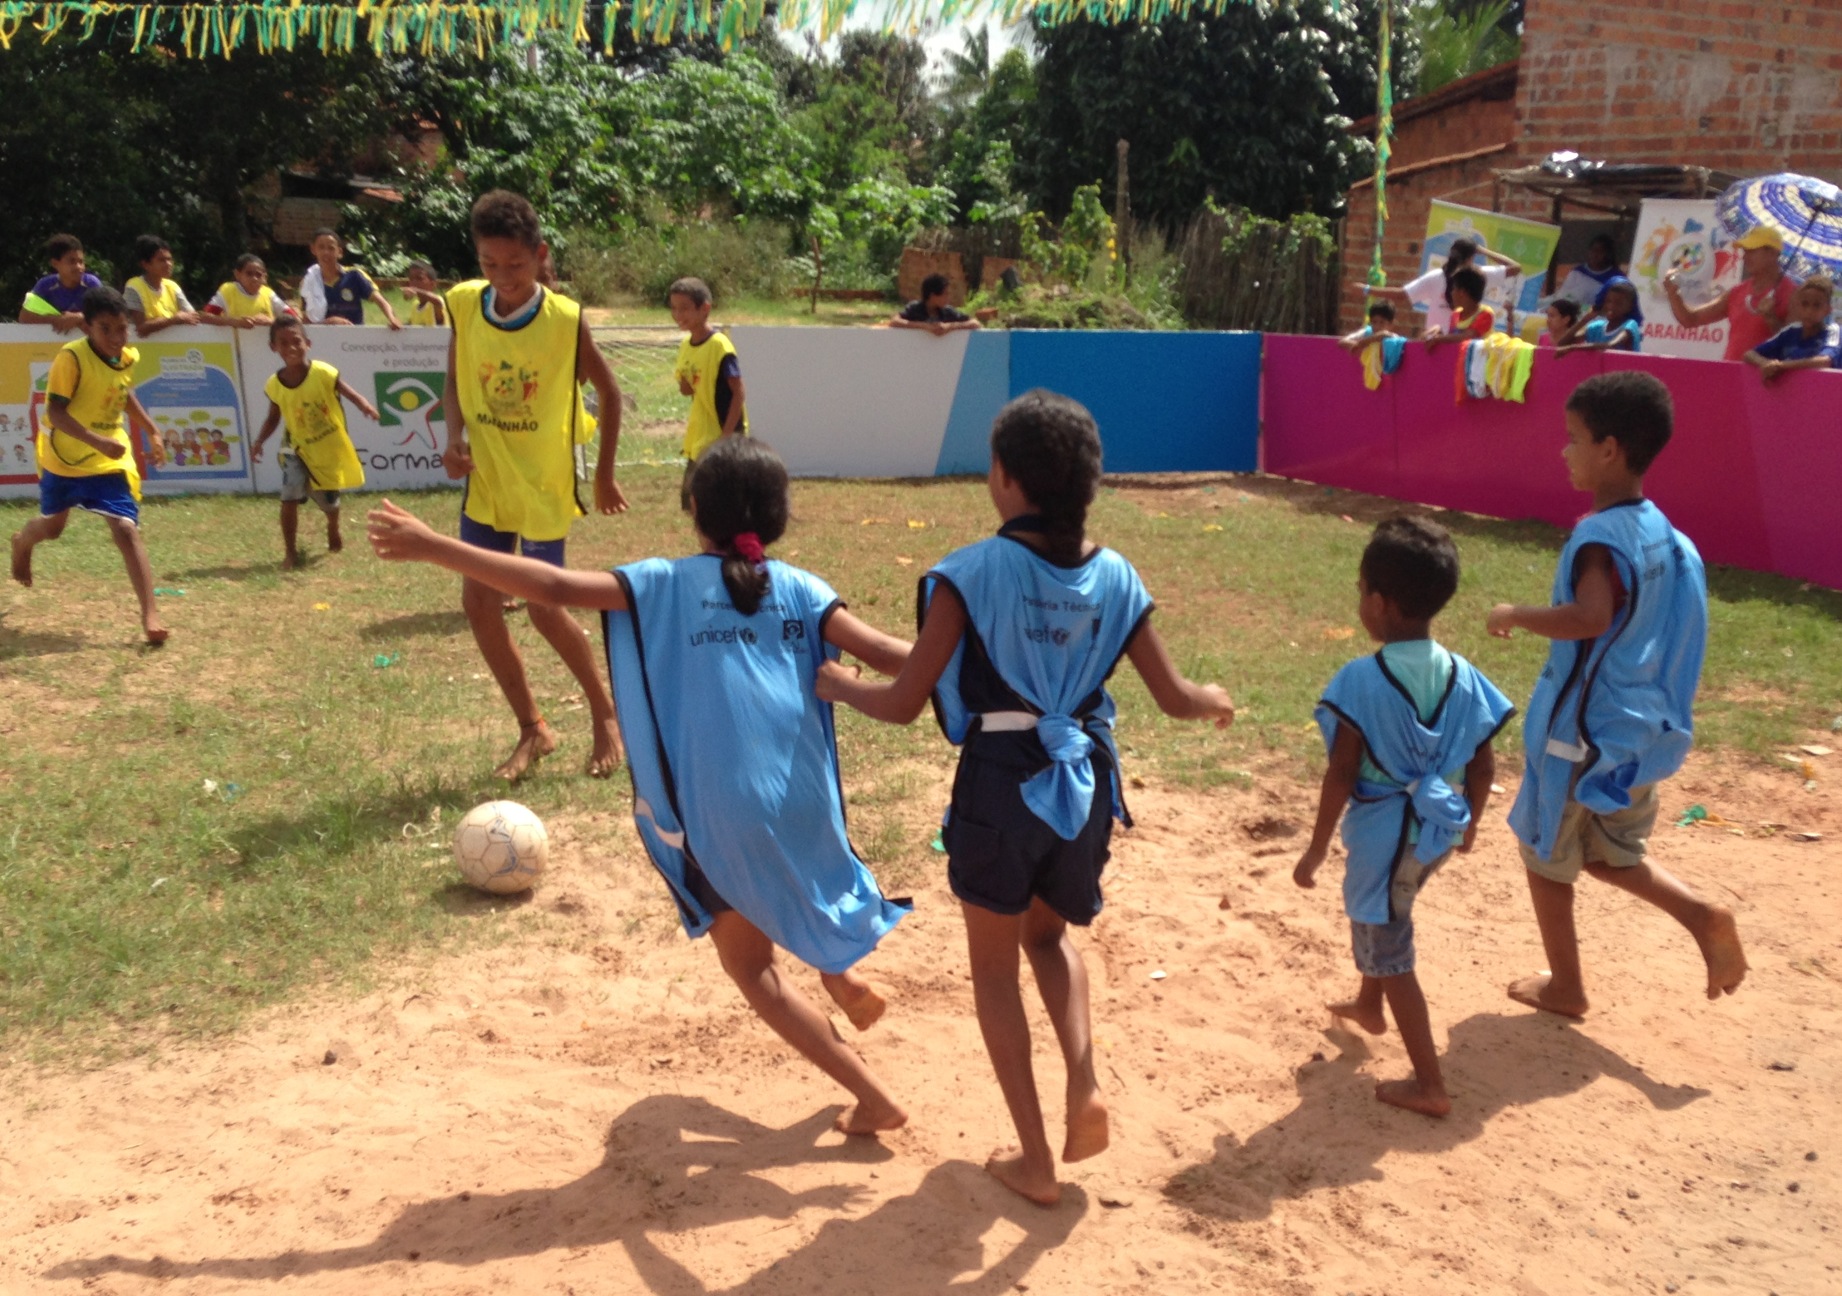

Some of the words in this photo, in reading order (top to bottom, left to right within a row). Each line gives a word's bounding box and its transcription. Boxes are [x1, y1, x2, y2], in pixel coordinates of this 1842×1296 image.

[1644, 323, 1724, 343] ARANHÃO
[383, 359, 390, 367] e
[392, 357, 440, 368] produção
[690, 625, 739, 647] unicef
